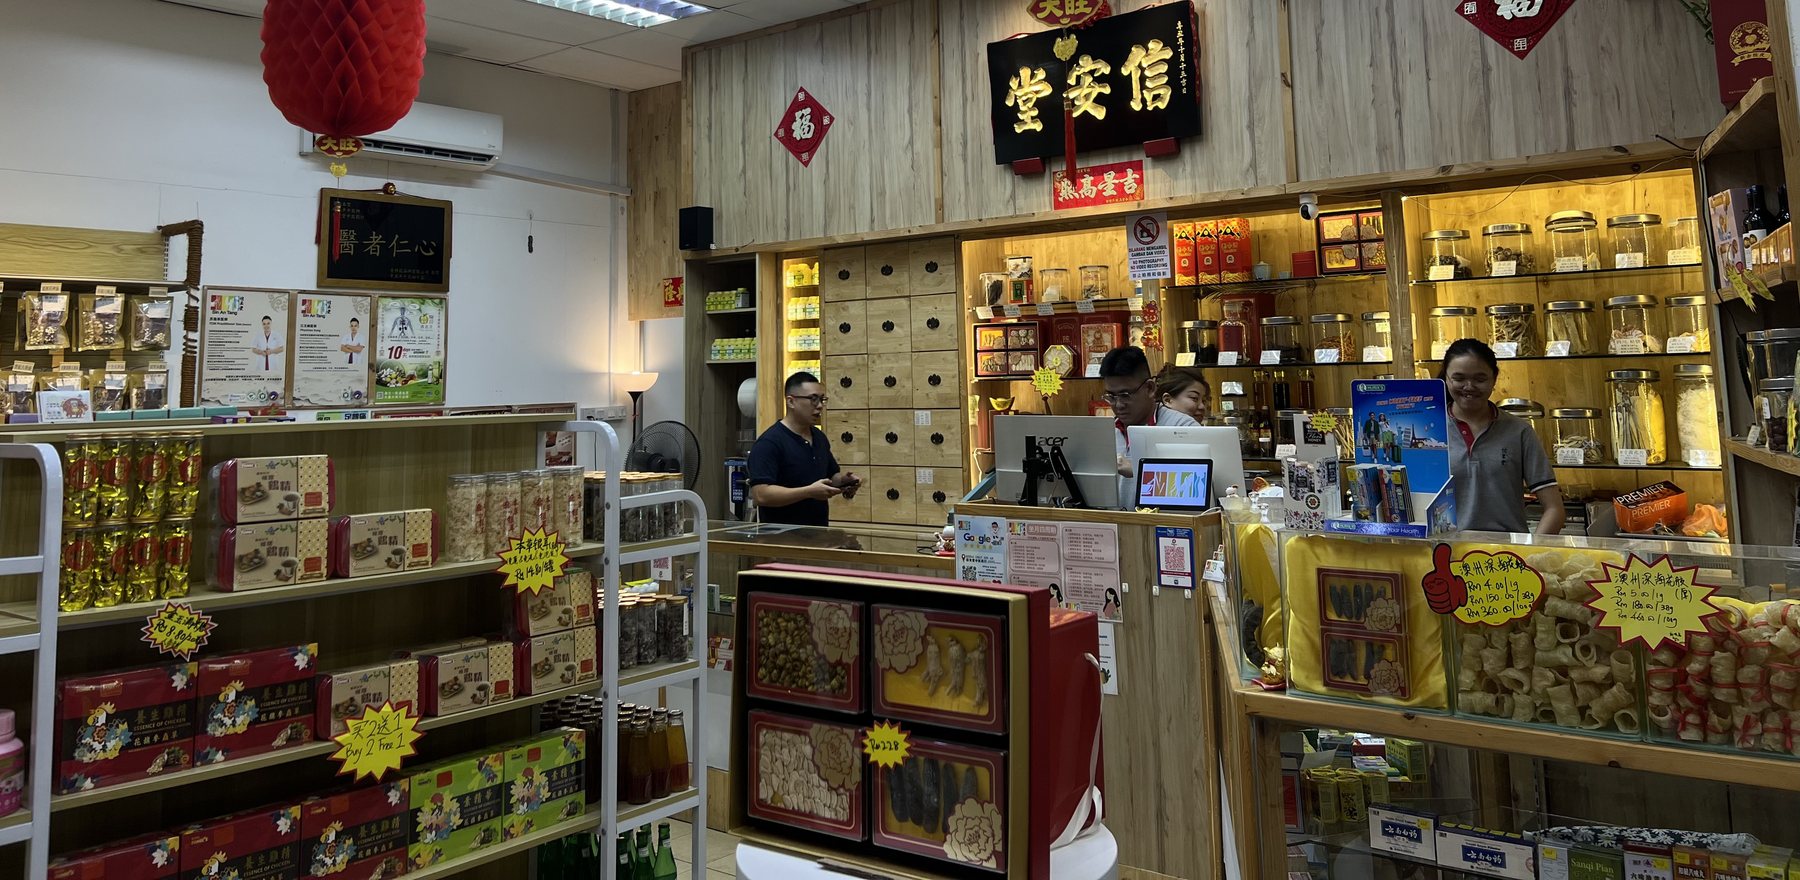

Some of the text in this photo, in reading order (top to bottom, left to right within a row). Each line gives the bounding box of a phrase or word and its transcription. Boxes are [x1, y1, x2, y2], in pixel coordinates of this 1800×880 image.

[791, 107, 816, 141] 福
[322, 137, 359, 152] 大旺
[339, 228, 437, 259] 醫者仁心
[1138, 257, 1165, 265] PHOTOGRAPHY
[388, 345, 403, 360] 10
[1037, 436, 1068, 447] acer
[1616, 482, 1668, 505] PREMIER
[1631, 499, 1672, 518] PREMIER
[963, 532, 991, 545] Google
[345, 733, 406, 765] Buy 2 Free 1
[1571, 857, 1615, 874] Sanqi Pian
